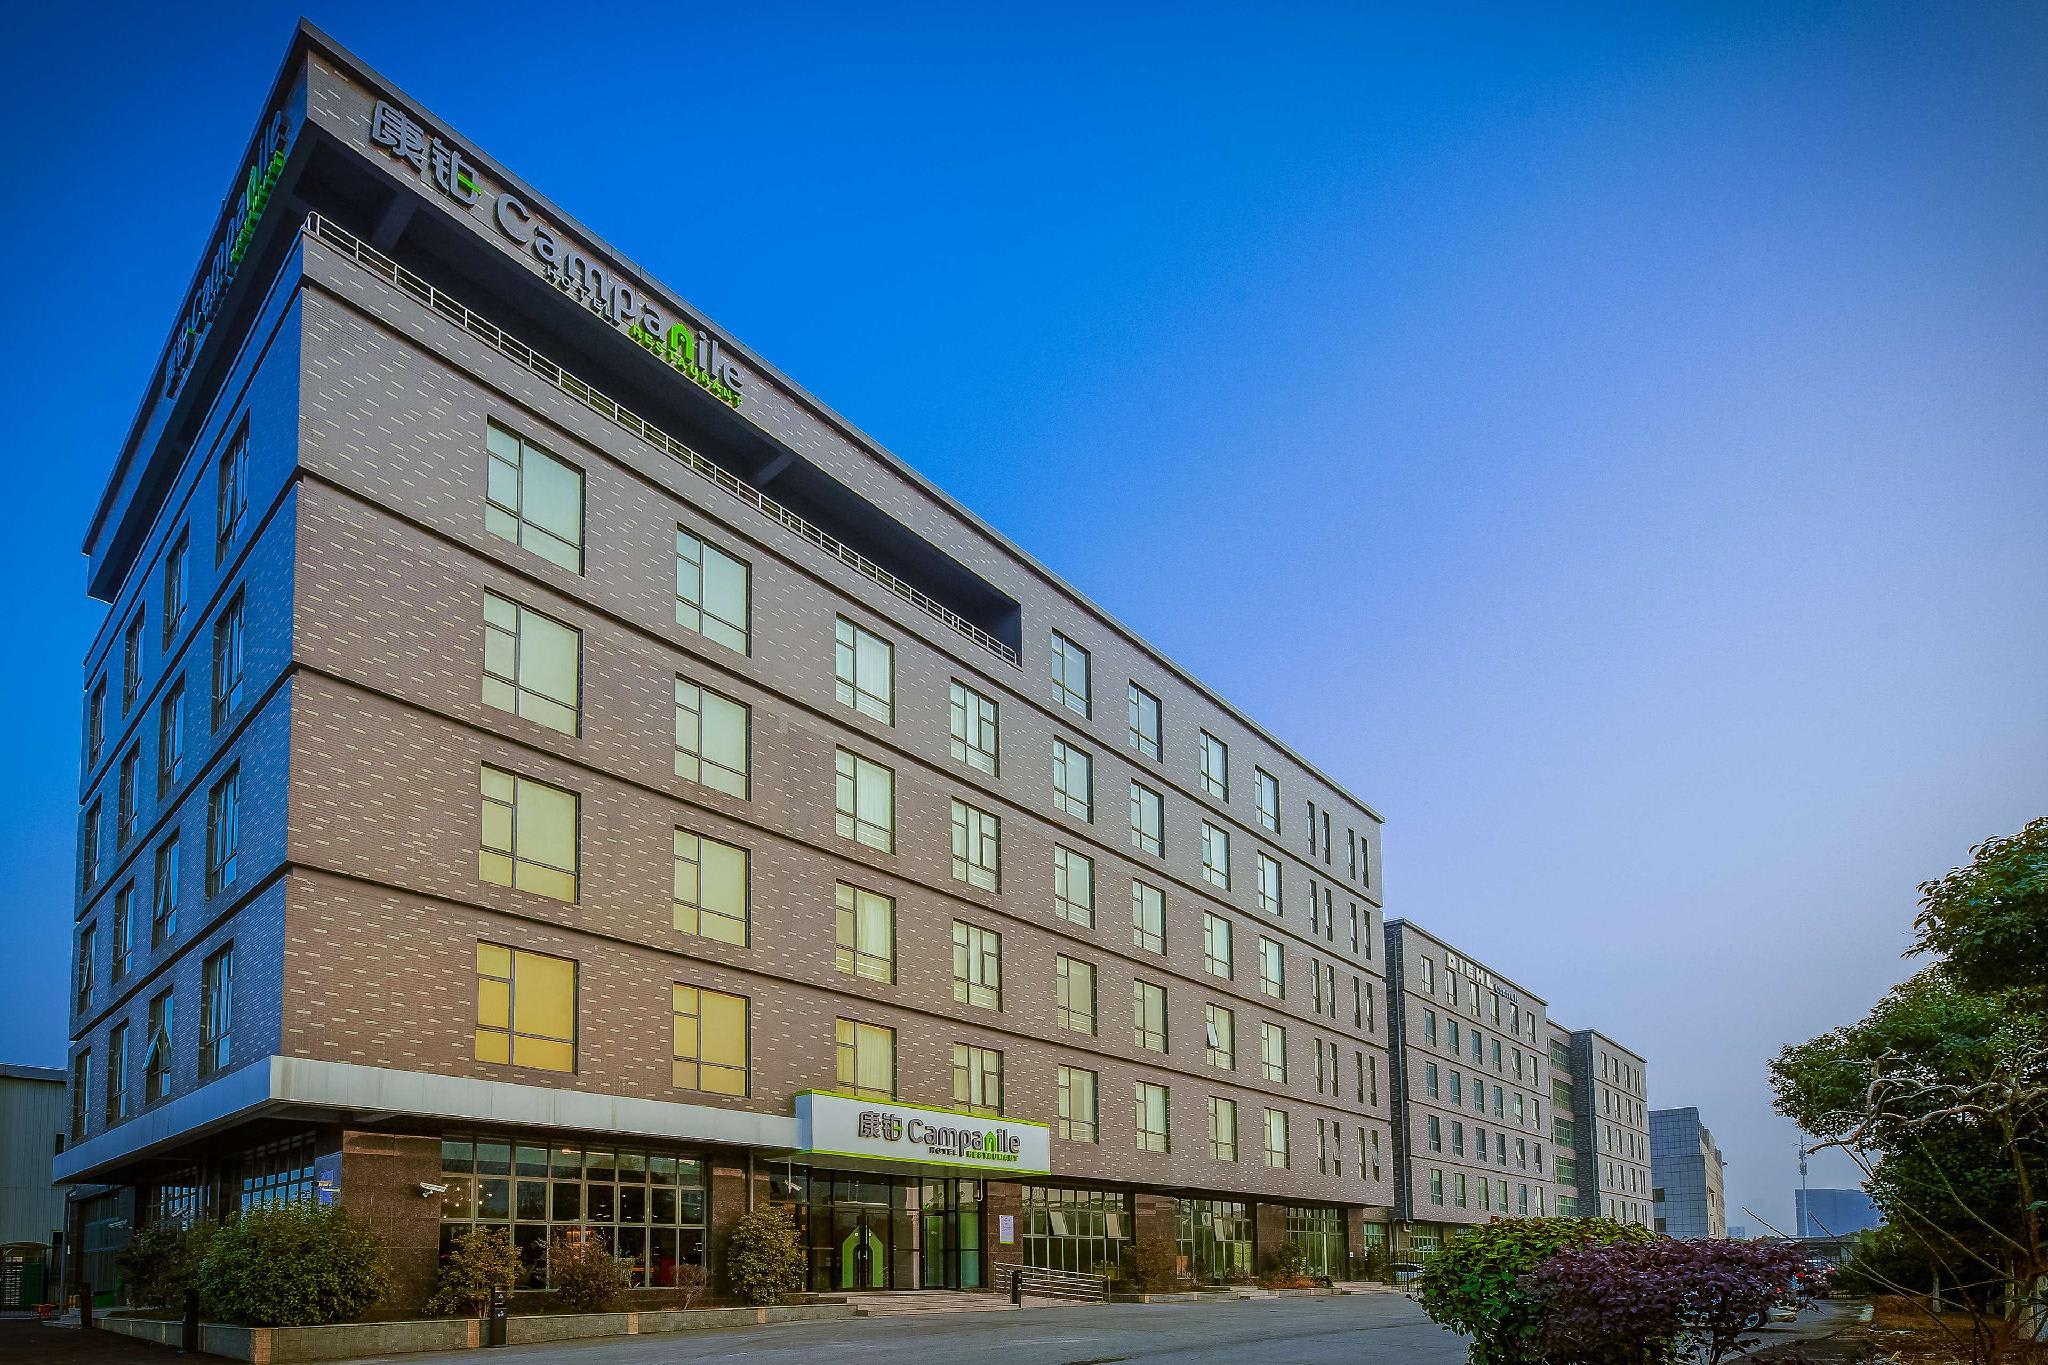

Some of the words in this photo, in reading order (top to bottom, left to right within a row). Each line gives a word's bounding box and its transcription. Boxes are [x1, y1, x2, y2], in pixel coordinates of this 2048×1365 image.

[493, 193, 745, 393] Campanile
[544, 265, 617, 326] HOTEL
[629, 323, 743, 407] RESTAURANT
[908, 1118, 1020, 1157] Campanile
[929, 1146, 958, 1156] HOTEL
